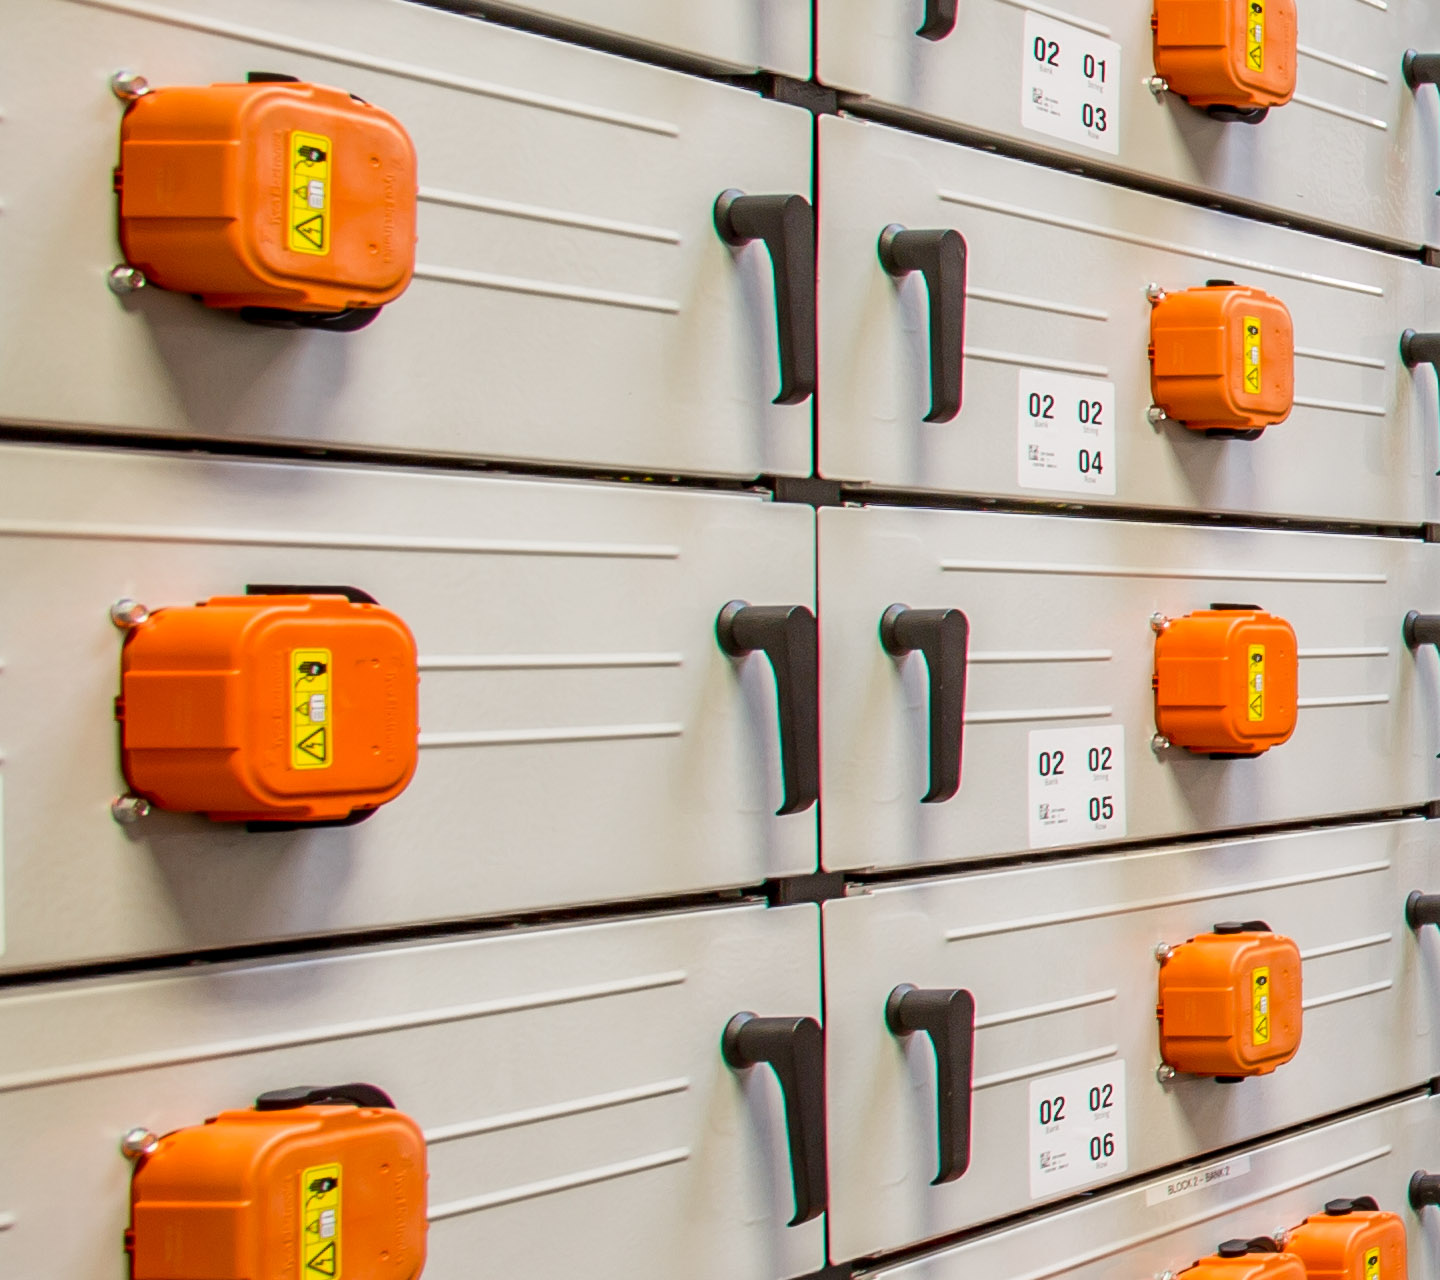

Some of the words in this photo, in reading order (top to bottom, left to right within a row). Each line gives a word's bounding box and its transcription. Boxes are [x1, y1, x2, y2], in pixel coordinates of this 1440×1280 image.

[1034, 36, 1060, 67] 02
[1083, 54, 1106, 83] 01
[1082, 103, 1107, 132] 03
[1029, 392, 1055, 419] 02
[1078, 399, 1103, 425] 02
[1079, 449, 1103, 475] 04
[1039, 750, 1064, 777] 02
[1088, 746, 1112, 772] 02
[1089, 795, 1114, 822] 05
[1039, 1096, 1065, 1125] 02
[1089, 1083, 1113, 1112] 02
[1090, 1132, 1115, 1161] 06
[1167, 1180, 1192, 1195] BLOCK
[1194, 1176, 1198, 1186] 2
[1205, 1169, 1224, 1182] BANK
[1225, 1166, 1230, 1175] 2
